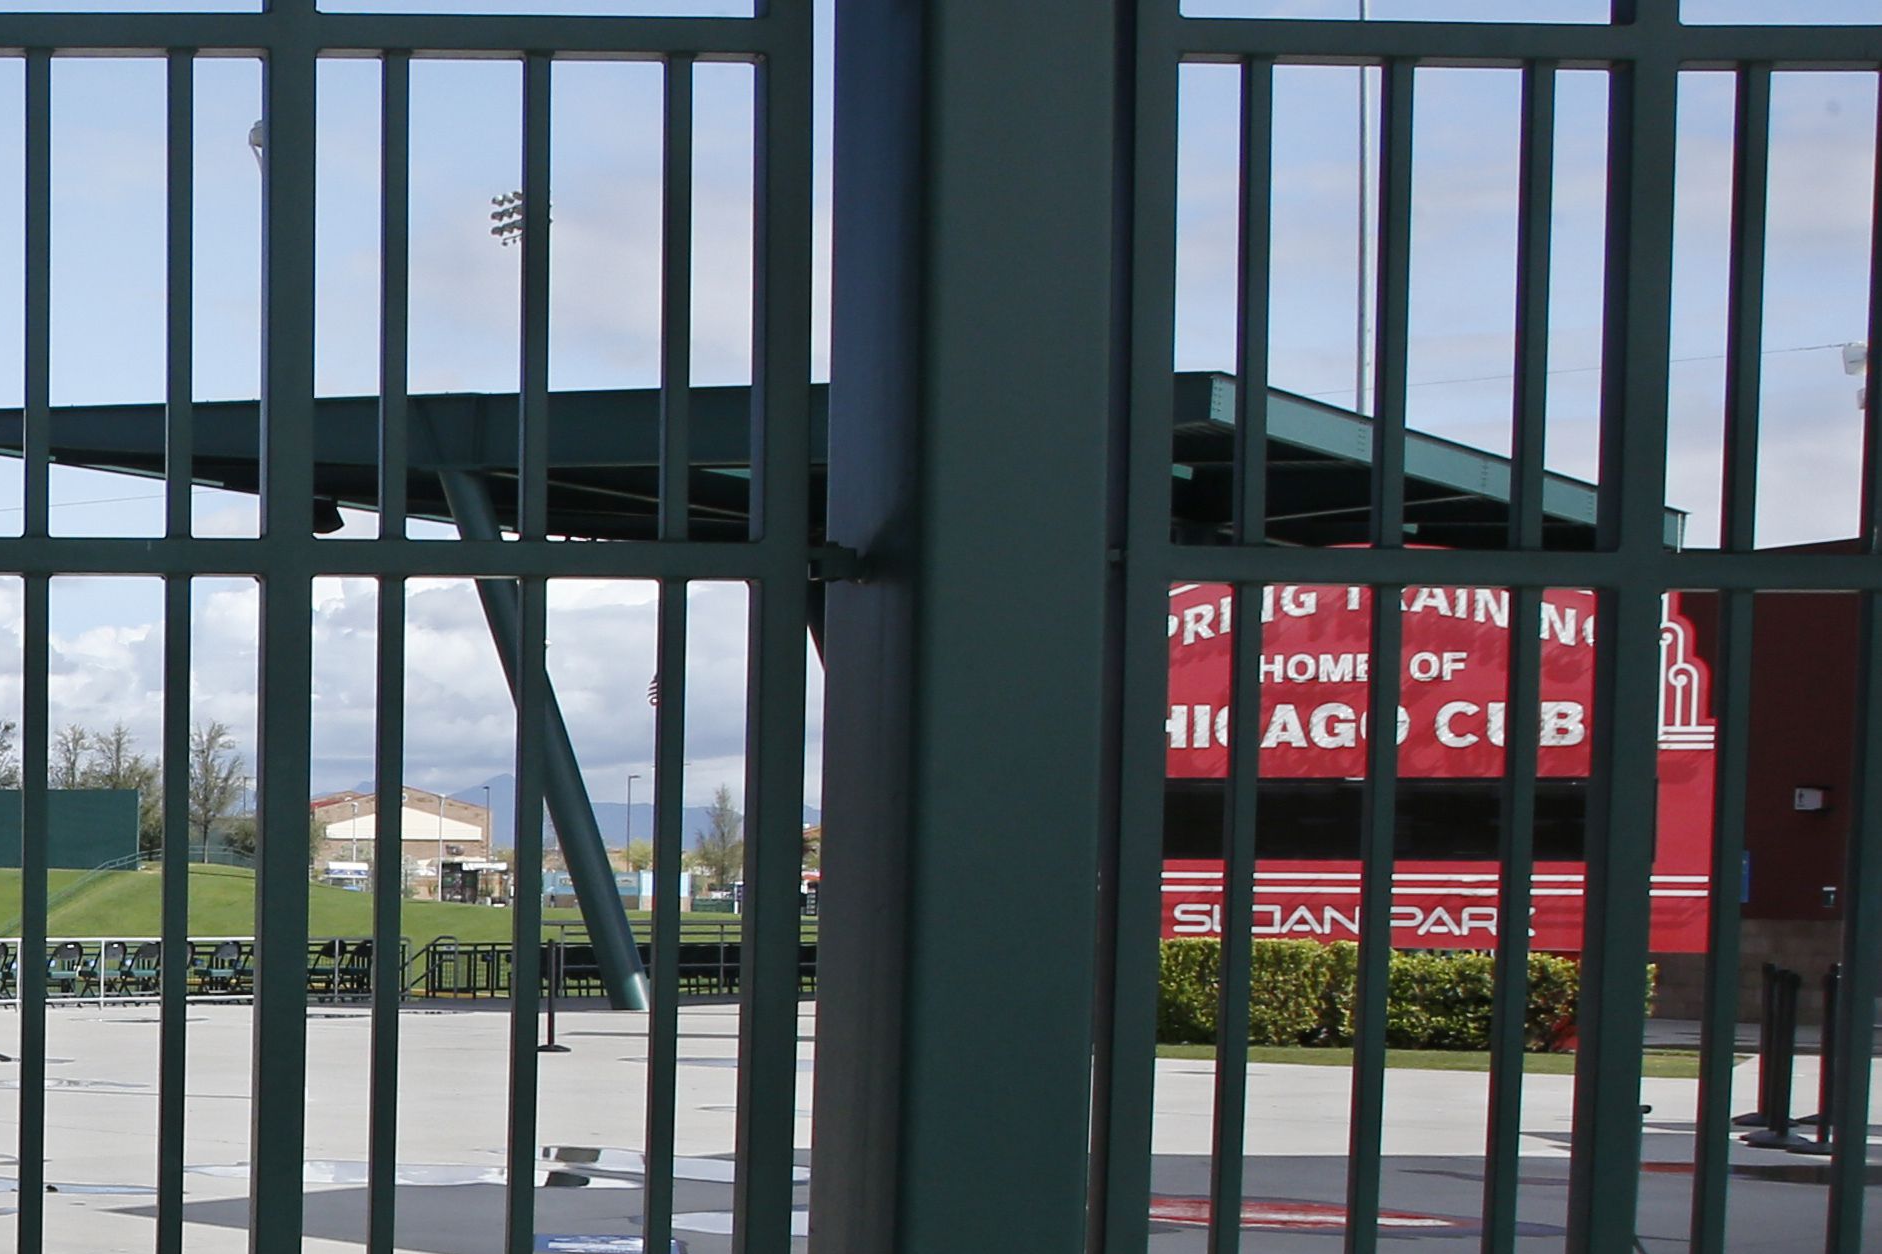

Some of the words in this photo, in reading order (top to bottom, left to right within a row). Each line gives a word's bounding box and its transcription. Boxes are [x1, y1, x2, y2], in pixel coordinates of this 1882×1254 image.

[1167, 586, 1318, 645] RIG
[1346, 586, 1595, 646] AINN
[1259, 653, 1369, 683] HOME
[1409, 652, 1468, 682] OF
[1165, 702, 1411, 749] HIAG
[1435, 701, 1586, 748] CB
[1390, 905, 1536, 937] PAR
